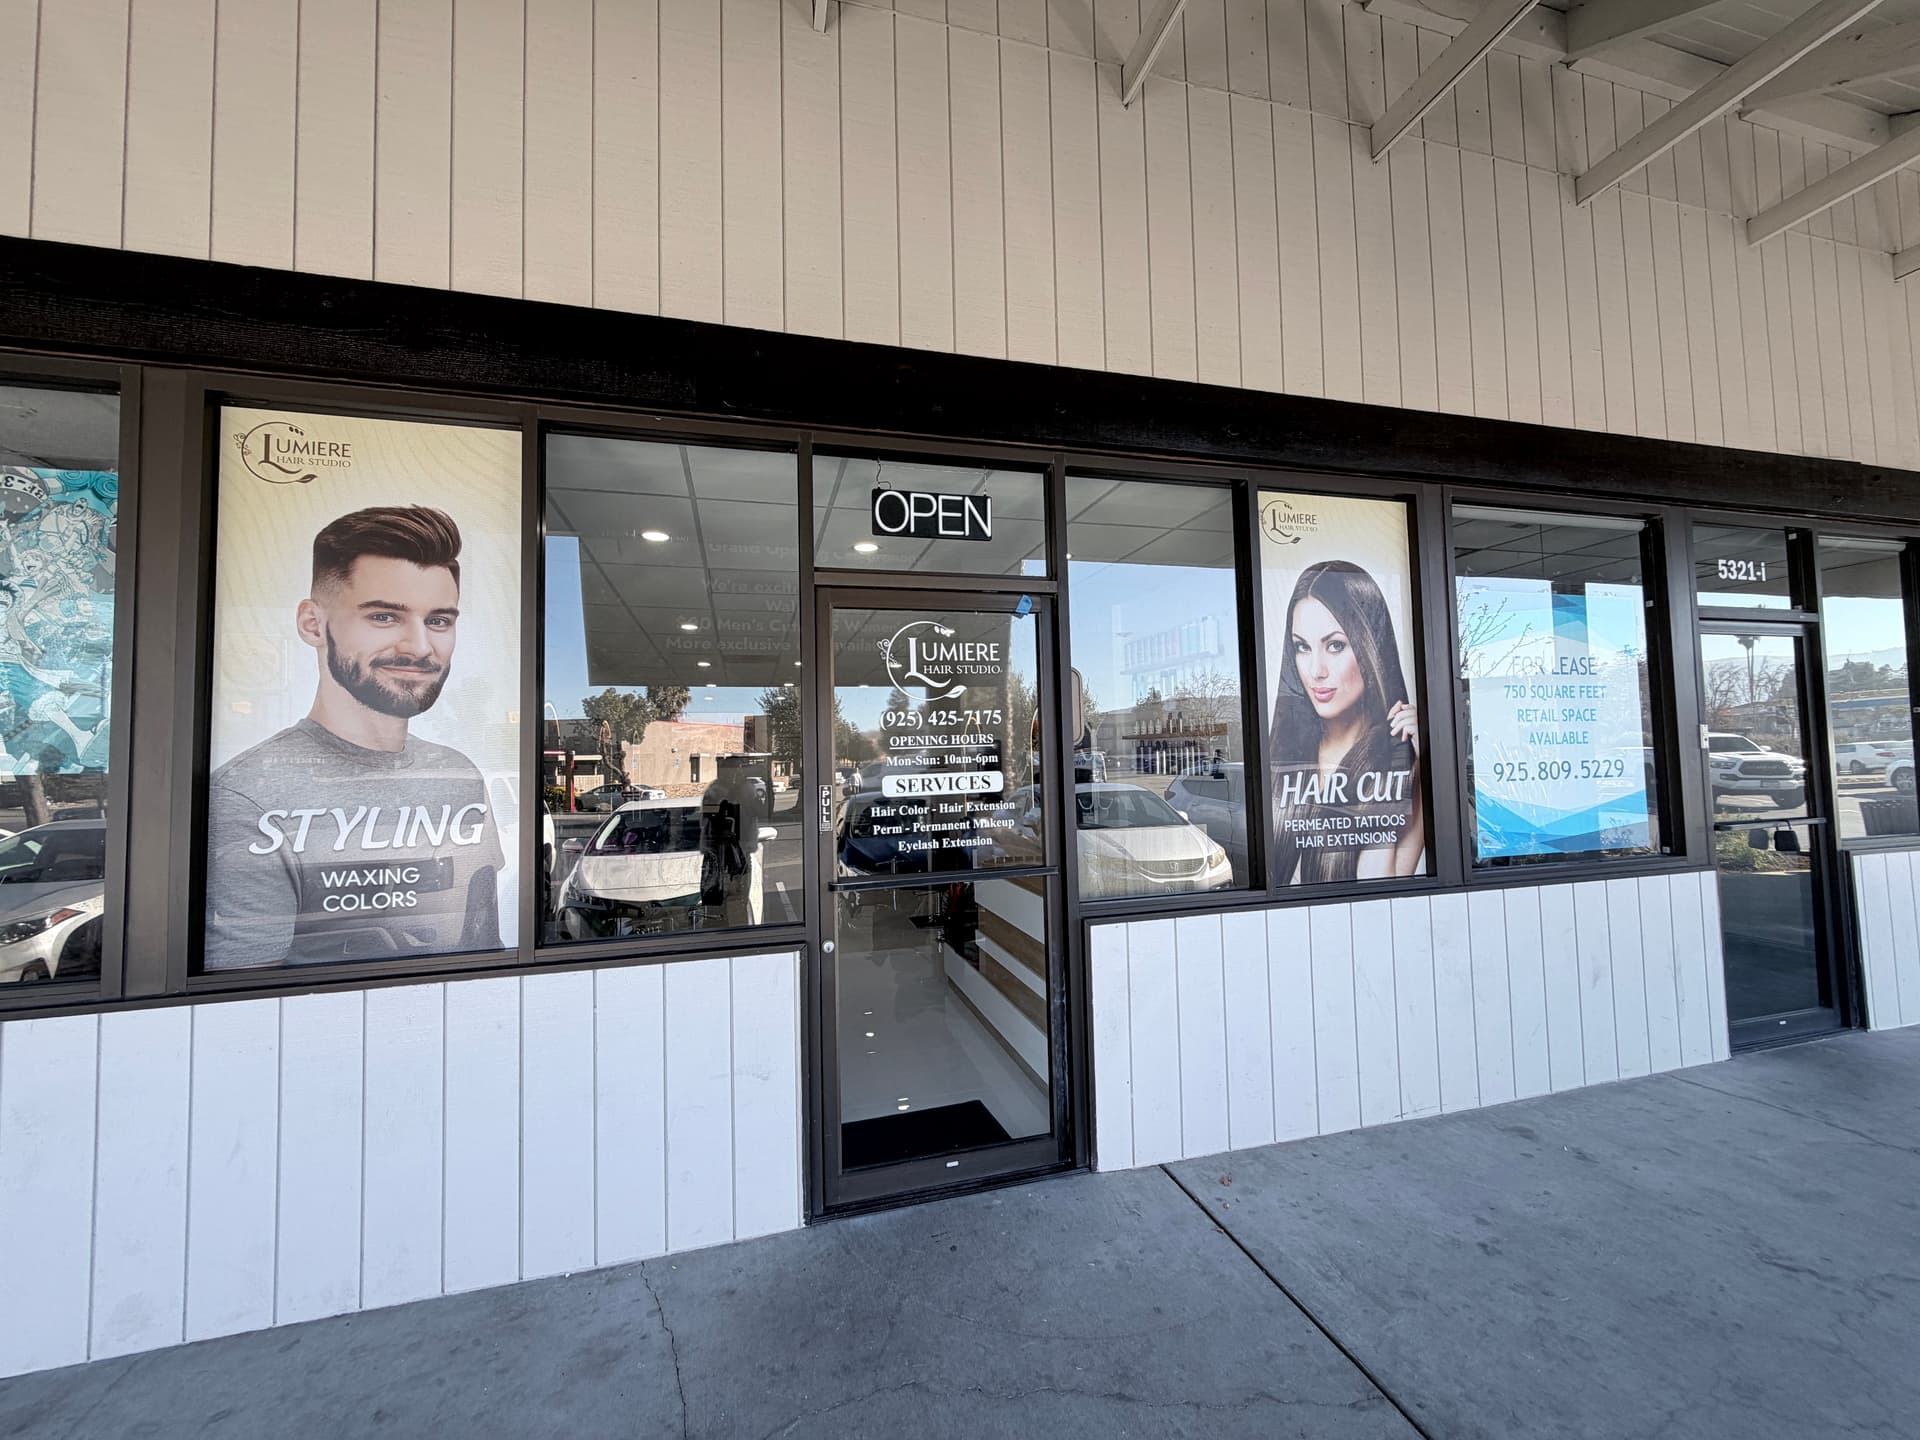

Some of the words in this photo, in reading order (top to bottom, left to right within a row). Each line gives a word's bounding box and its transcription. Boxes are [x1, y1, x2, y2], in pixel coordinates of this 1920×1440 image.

[276, 455, 305, 465] HAIR
[308, 457, 351, 468] STUDIO
[875, 490, 991, 537] OPEN
[1718, 559, 1766, 582] 5321-i
[923, 665, 953, 674] HAIR
[956, 665, 1001, 674] STUDIO
[1512, 655, 1545, 675] FOR
[1551, 656, 1597, 676] LEASE
[1504, 684, 1526, 699] 750
[1530, 685, 1575, 700] SQUARE
[1580, 685, 1606, 698] FEET
[880, 710, 923, 730] (925)
[927, 709, 1002, 727] 425-7175
[1517, 708, 1558, 722] RETAIL
[1562, 708, 1597, 721] SPACE
[889, 735, 948, 747] OPENING
[951, 733, 994, 745] HOURS
[1529, 731, 1589, 744] AVAILABLE
[886, 755, 941, 767] Mon-Sun:
[944, 753, 999, 766] 10am-6pm
[1493, 759, 1624, 782] 925.809.5229
[895, 775, 991, 793] SERVICES
[1280, 771, 1349, 808] HAIR
[1356, 770, 1410, 803] CUT
[822, 790, 830, 823] PULL
[871, 806, 896, 817] Hair
[899, 805, 930, 815] Color
[939, 803, 963, 813] Hair
[966, 801, 1016, 812] Extension
[248, 803, 488, 855] STYLING
[873, 824, 903, 835] Perm
[912, 820, 970, 833] Permanent
[973, 818, 1015, 828] Makeup
[1284, 817, 1352, 832] PERMEATED
[1354, 814, 1406, 829] TATTOOS
[898, 840, 940, 853] Eyelash
[942, 836, 993, 848] Extension
[1295, 836, 1325, 849] HAIR
[1327, 831, 1397, 847] EXTENSIONS
[321, 867, 421, 888] WAXING
[323, 891, 418, 912] COLORS
